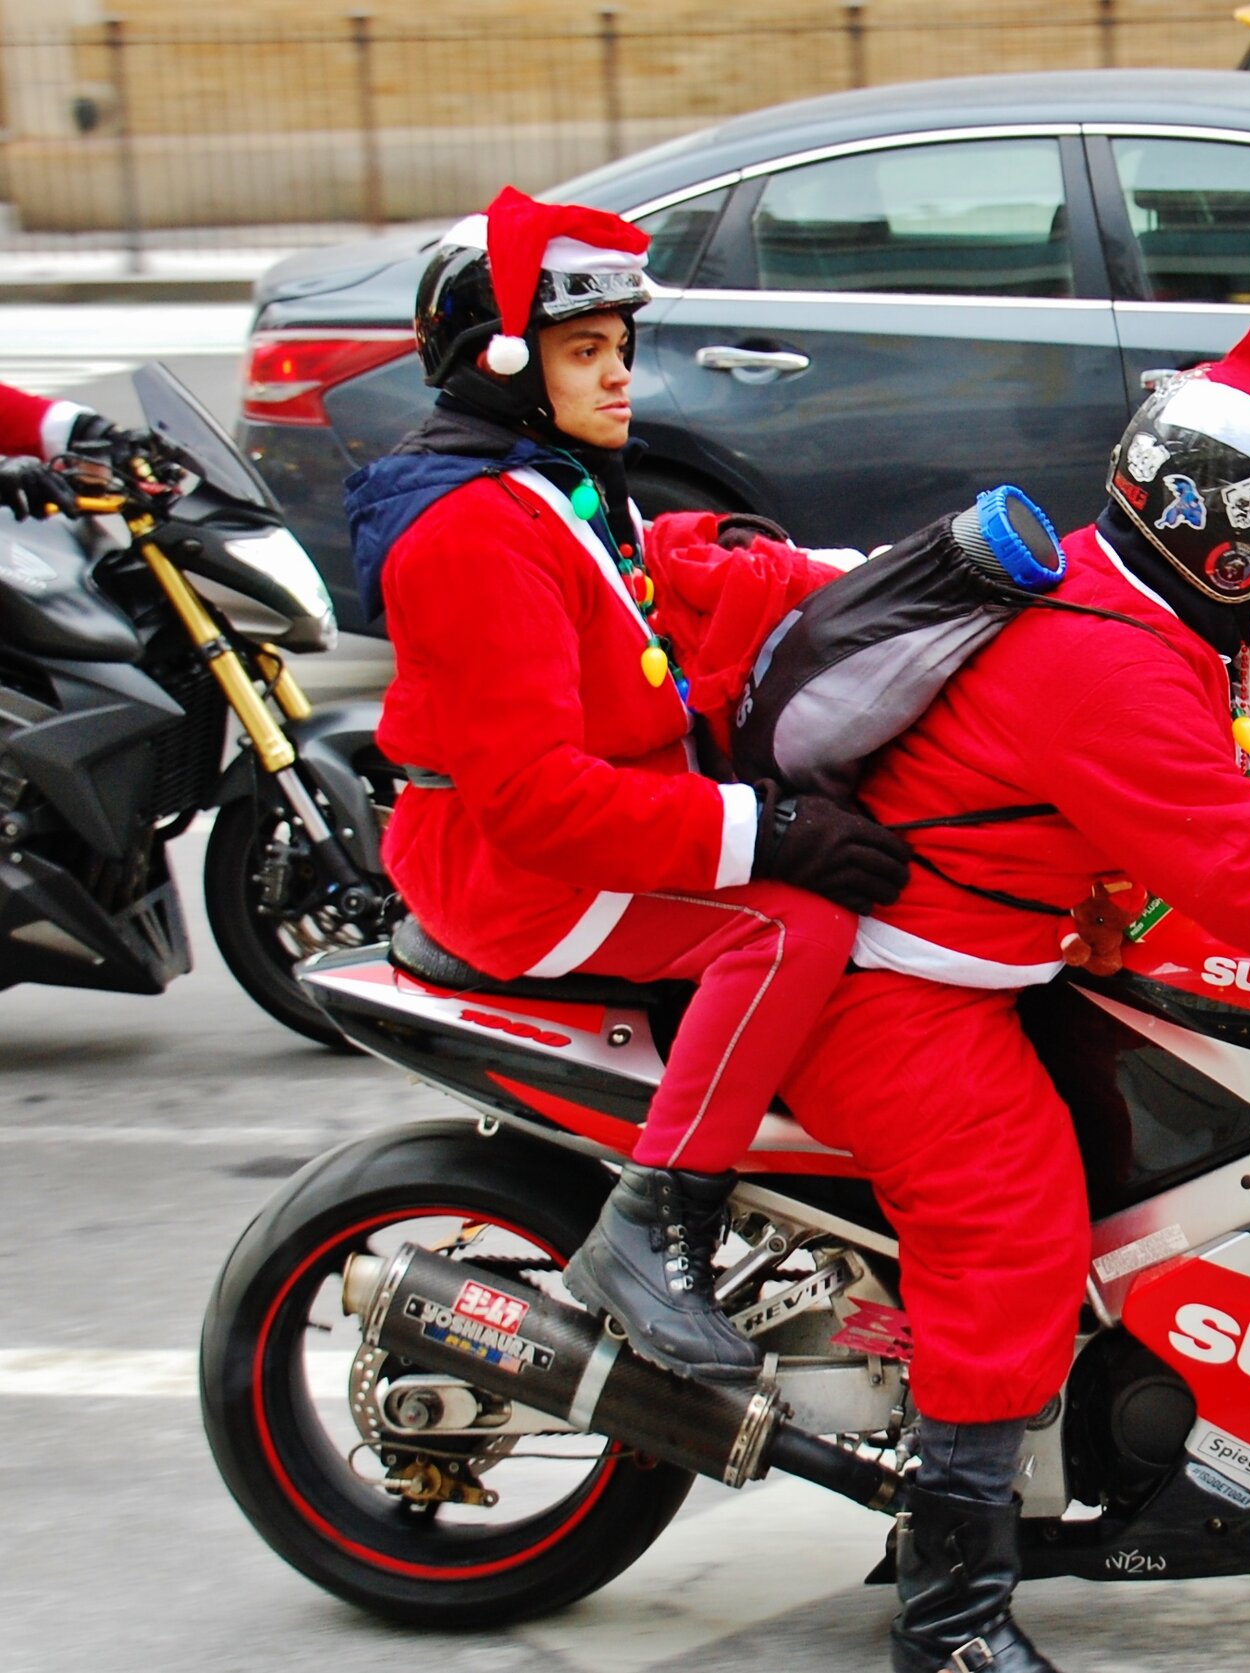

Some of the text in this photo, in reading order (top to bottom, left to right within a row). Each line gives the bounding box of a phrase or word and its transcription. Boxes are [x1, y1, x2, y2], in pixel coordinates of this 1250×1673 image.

[459, 1009, 572, 1048] 1000
[459, 1284, 524, 1328] ヨシムラ
[420, 1302, 536, 1364] YOSHIMURA
